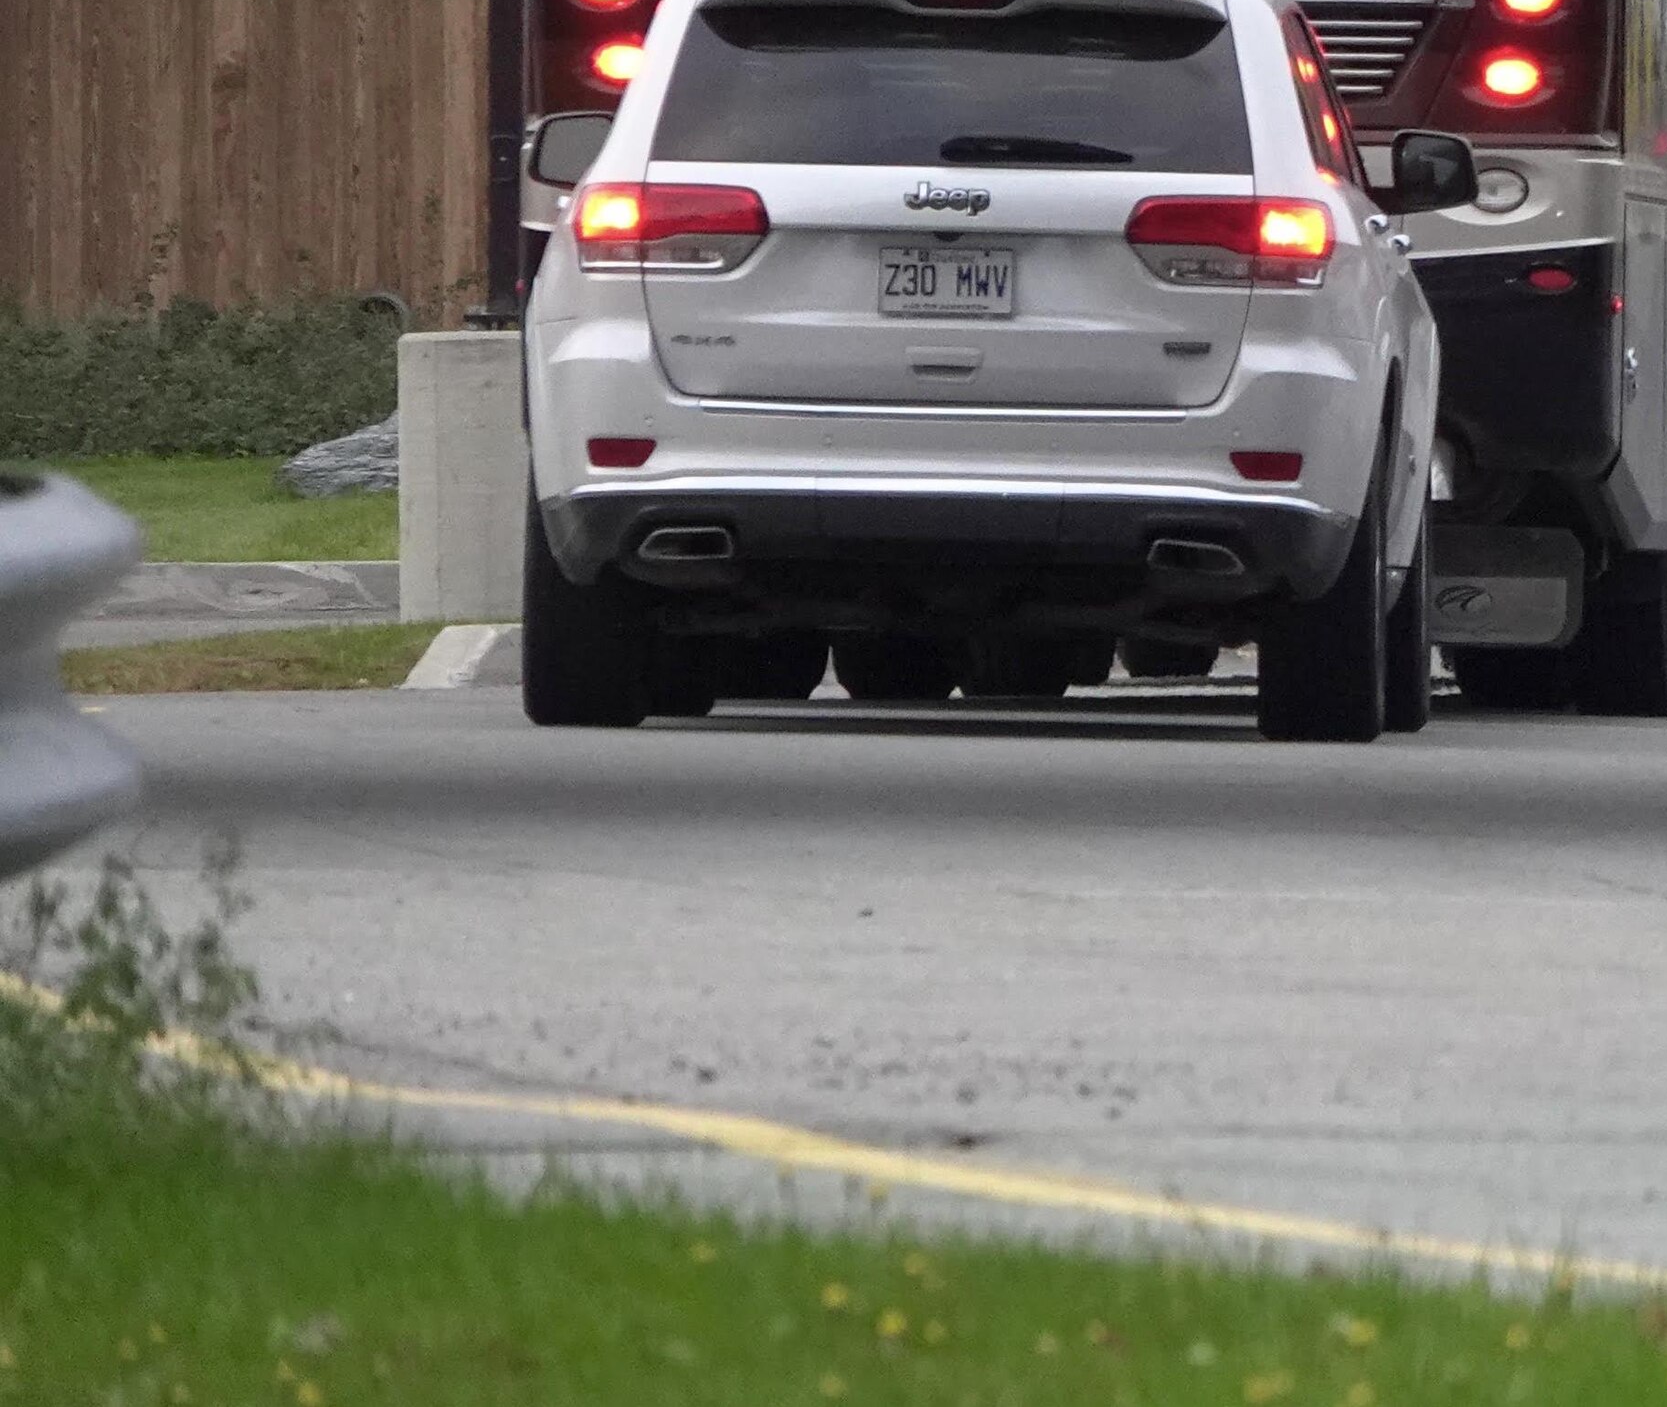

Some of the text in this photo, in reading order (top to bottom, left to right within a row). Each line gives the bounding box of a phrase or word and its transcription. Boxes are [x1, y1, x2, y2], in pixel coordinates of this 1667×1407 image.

[904, 181, 991, 216] Jeep
[884, 263, 1009, 297] Z30 MWV
